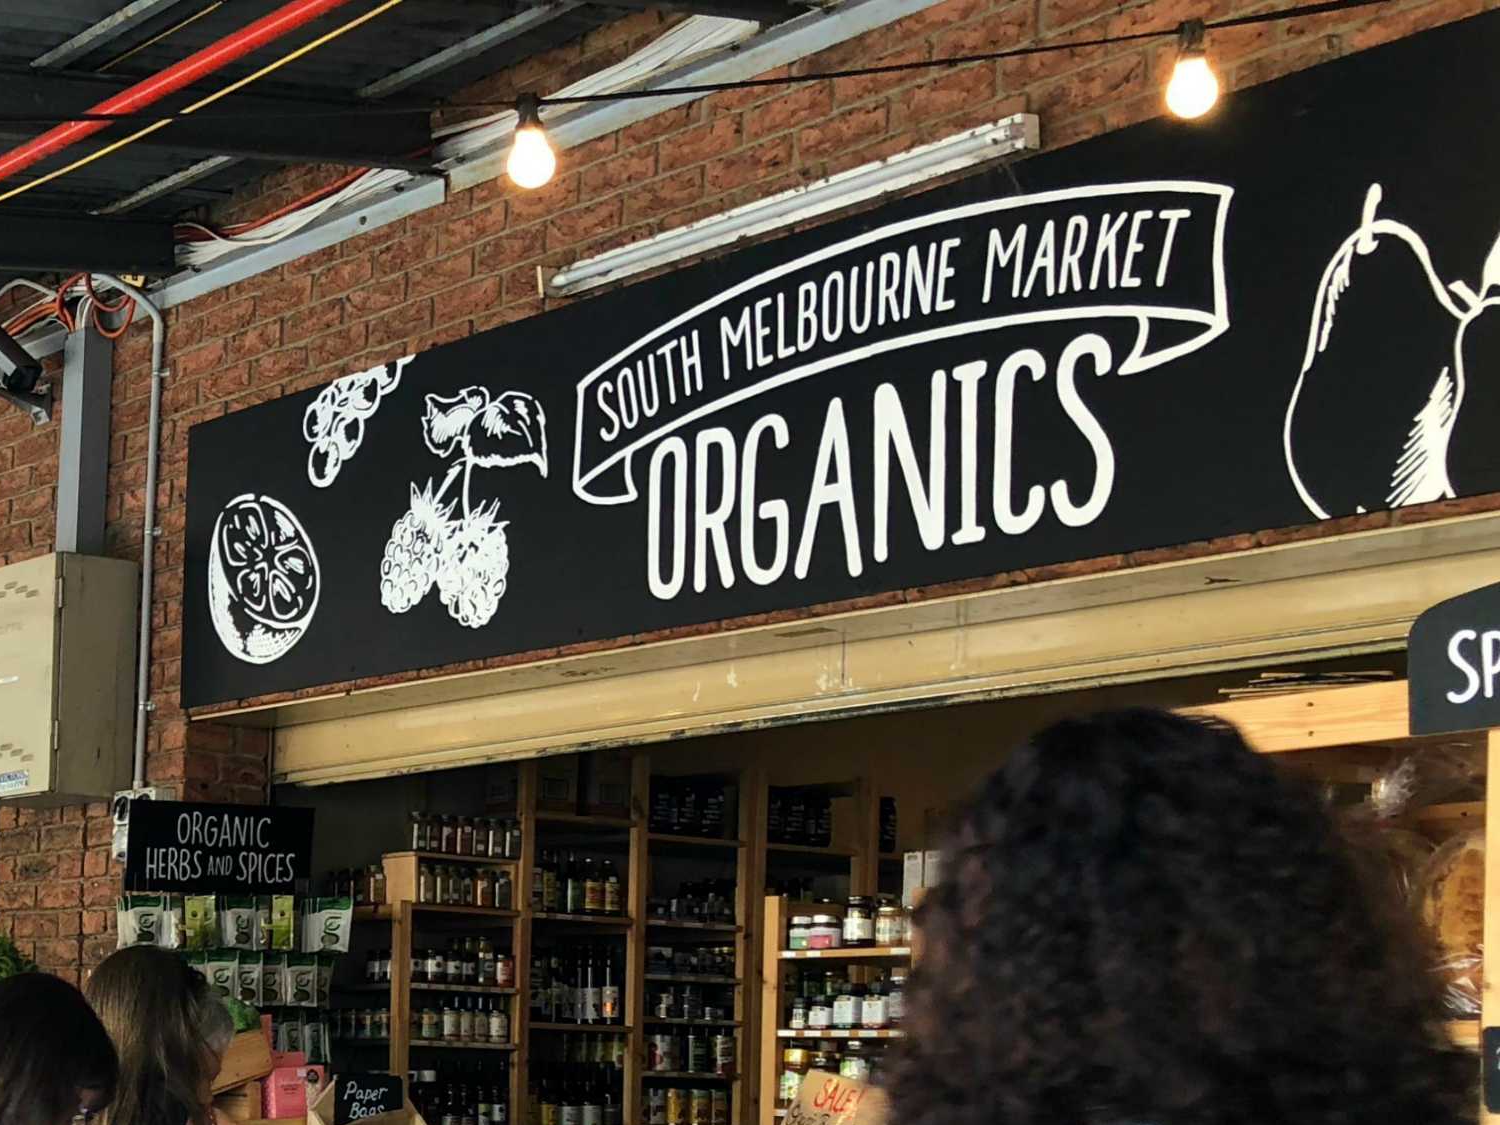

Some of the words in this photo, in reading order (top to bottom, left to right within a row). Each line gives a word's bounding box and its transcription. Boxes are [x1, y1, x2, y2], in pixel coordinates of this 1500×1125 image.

[597, 333, 706, 443] SOUTH
[719, 237, 957, 381] MELBOURNE
[981, 208, 1191, 302] MARKET
[647, 332, 1116, 600] ORGANICS
[1446, 629, 1500, 704] SP
[177, 811, 271, 848] ORGANIC
[146, 847, 203, 882] HERBS
[207, 857, 233, 876] AND
[236, 851, 295, 884] SPICES
[343, 1080, 388, 1104] Paper
